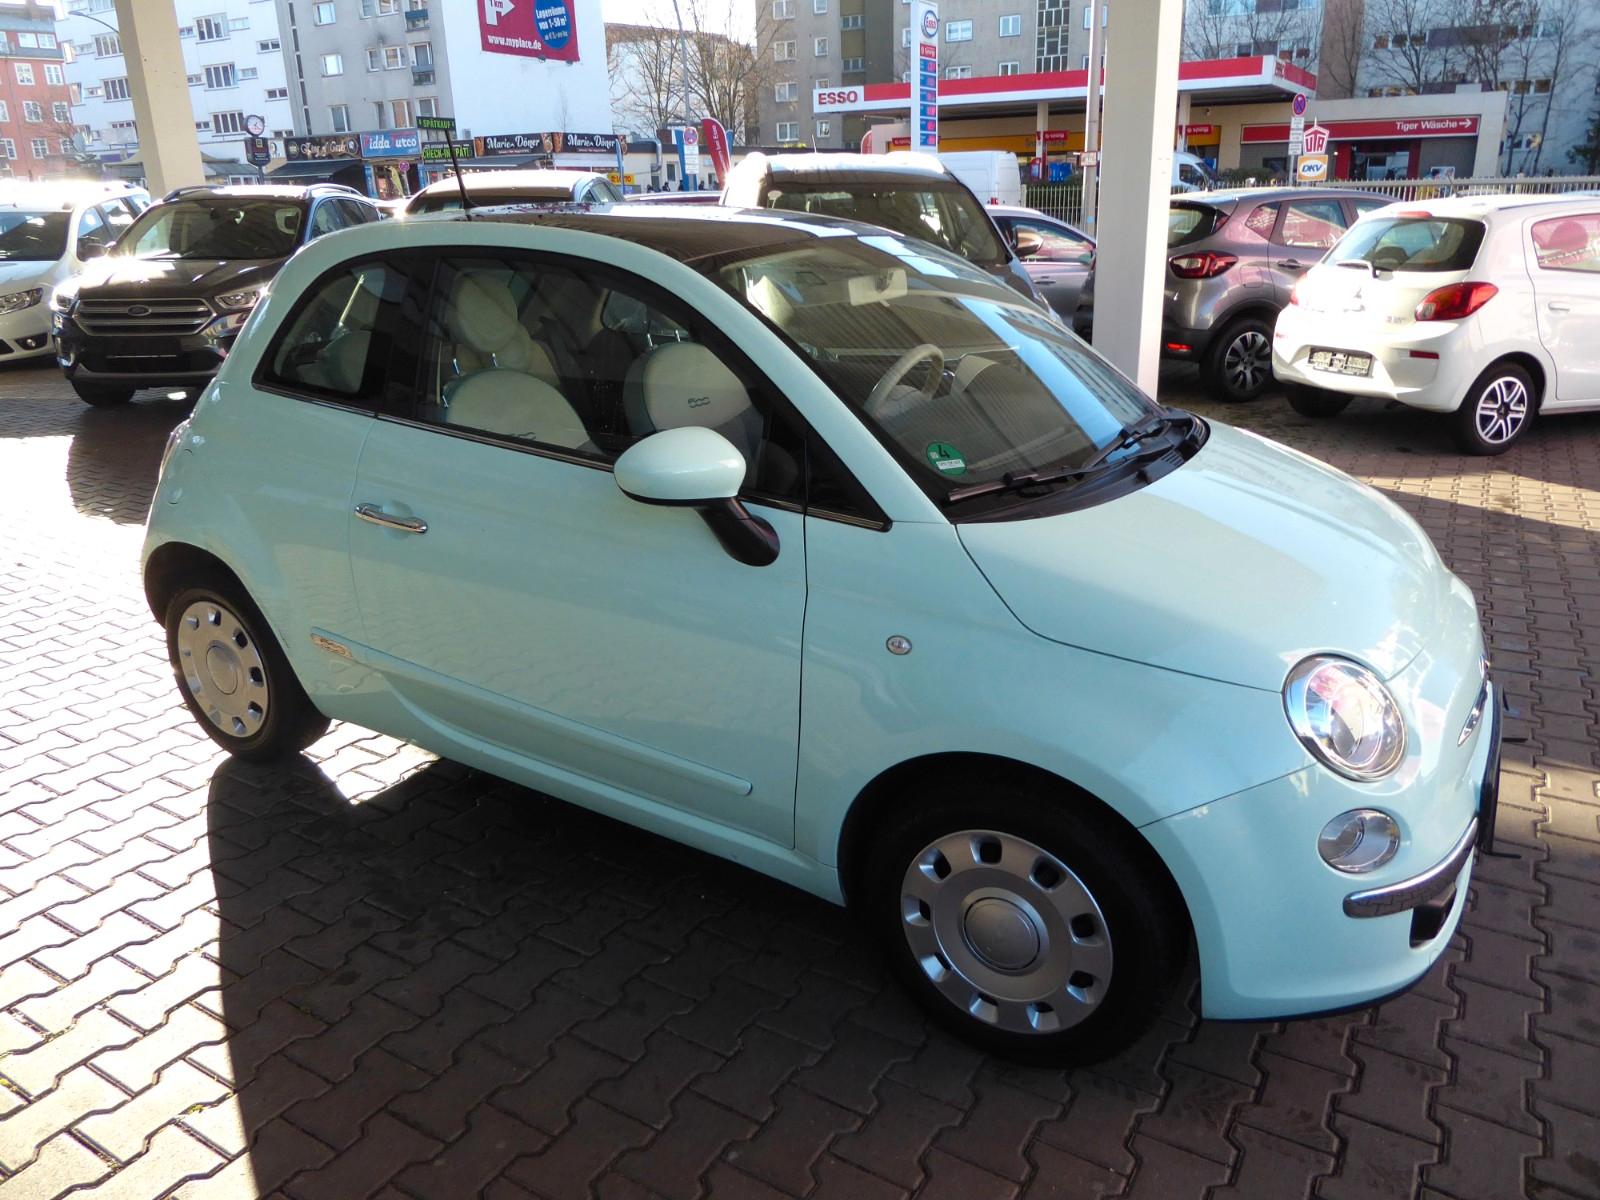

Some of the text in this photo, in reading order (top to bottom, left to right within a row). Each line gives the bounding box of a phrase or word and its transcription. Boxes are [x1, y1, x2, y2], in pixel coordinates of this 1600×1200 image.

[488, 35, 542, 50] www.myplace.de
[818, 91, 858, 105] ESSO
[1396, 120, 1457, 132] Tiger Wäsche
[515, 136, 540, 149] Döner
[595, 135, 616, 149] Döner
[1305, 130, 1326, 152] UTA
[1302, 164, 1322, 173] DKV
